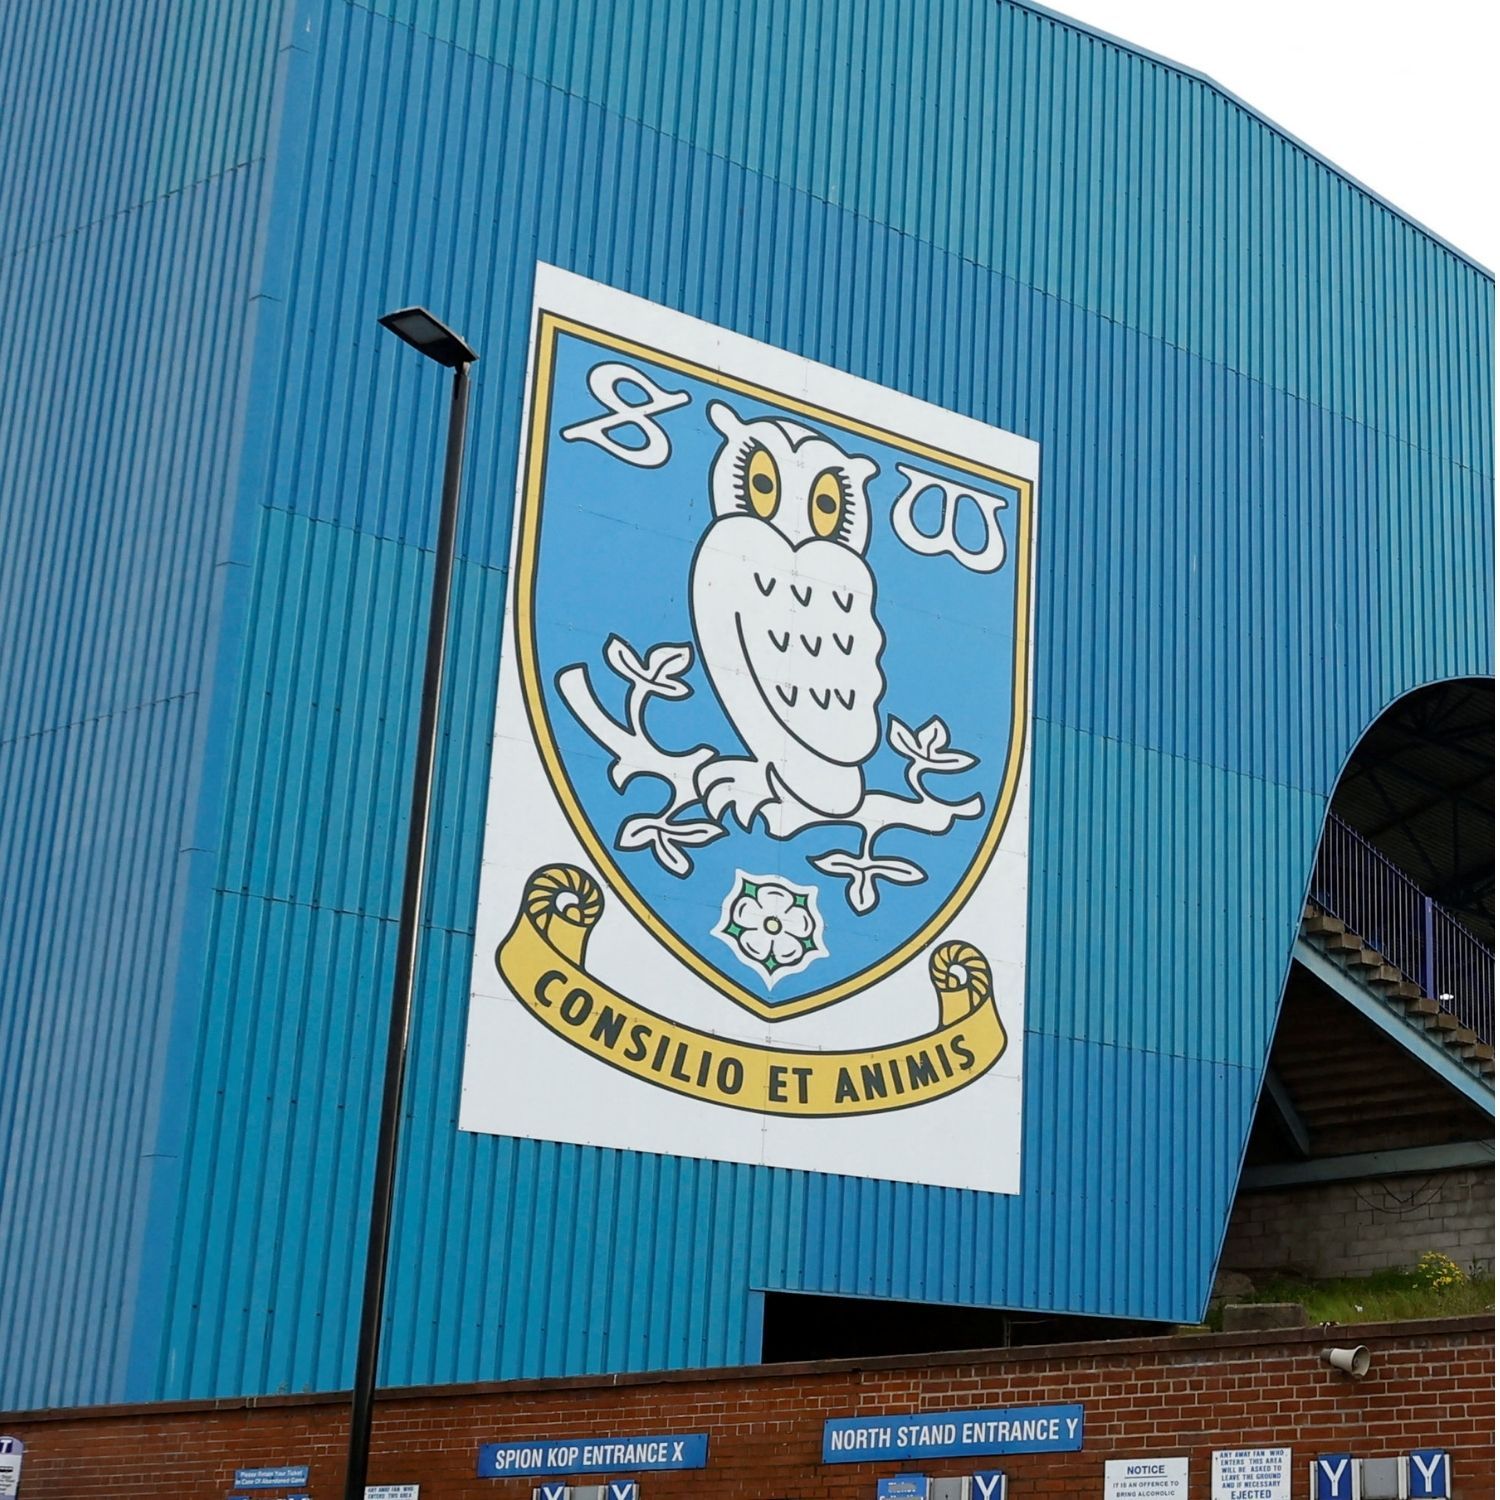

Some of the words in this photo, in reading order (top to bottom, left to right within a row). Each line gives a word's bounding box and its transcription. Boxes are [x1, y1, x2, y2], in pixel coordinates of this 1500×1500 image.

[534, 969, 744, 1095] CONSILIO
[768, 1065, 814, 1104] ET
[834, 1033, 976, 1104] ANIMIS
[830, 1427, 891, 1451] NORTH
[897, 1424, 956, 1447] STAND
[962, 1419, 1059, 1444] ENTRANCE
[1064, 1418, 1079, 1439] Y
[495, 1448, 542, 1470] SPION
[547, 1446, 579, 1468] KOP
[583, 1443, 668, 1466] ENTRANCE
[672, 1442, 685, 1461] X
[1127, 1464, 1165, 1475] NOTICE
[974, 1475, 1000, 1500] Y
[1320, 1459, 1348, 1497] Y
[1412, 1454, 1442, 1492] Y
[1231, 1489, 1271, 1500] EJECTED
